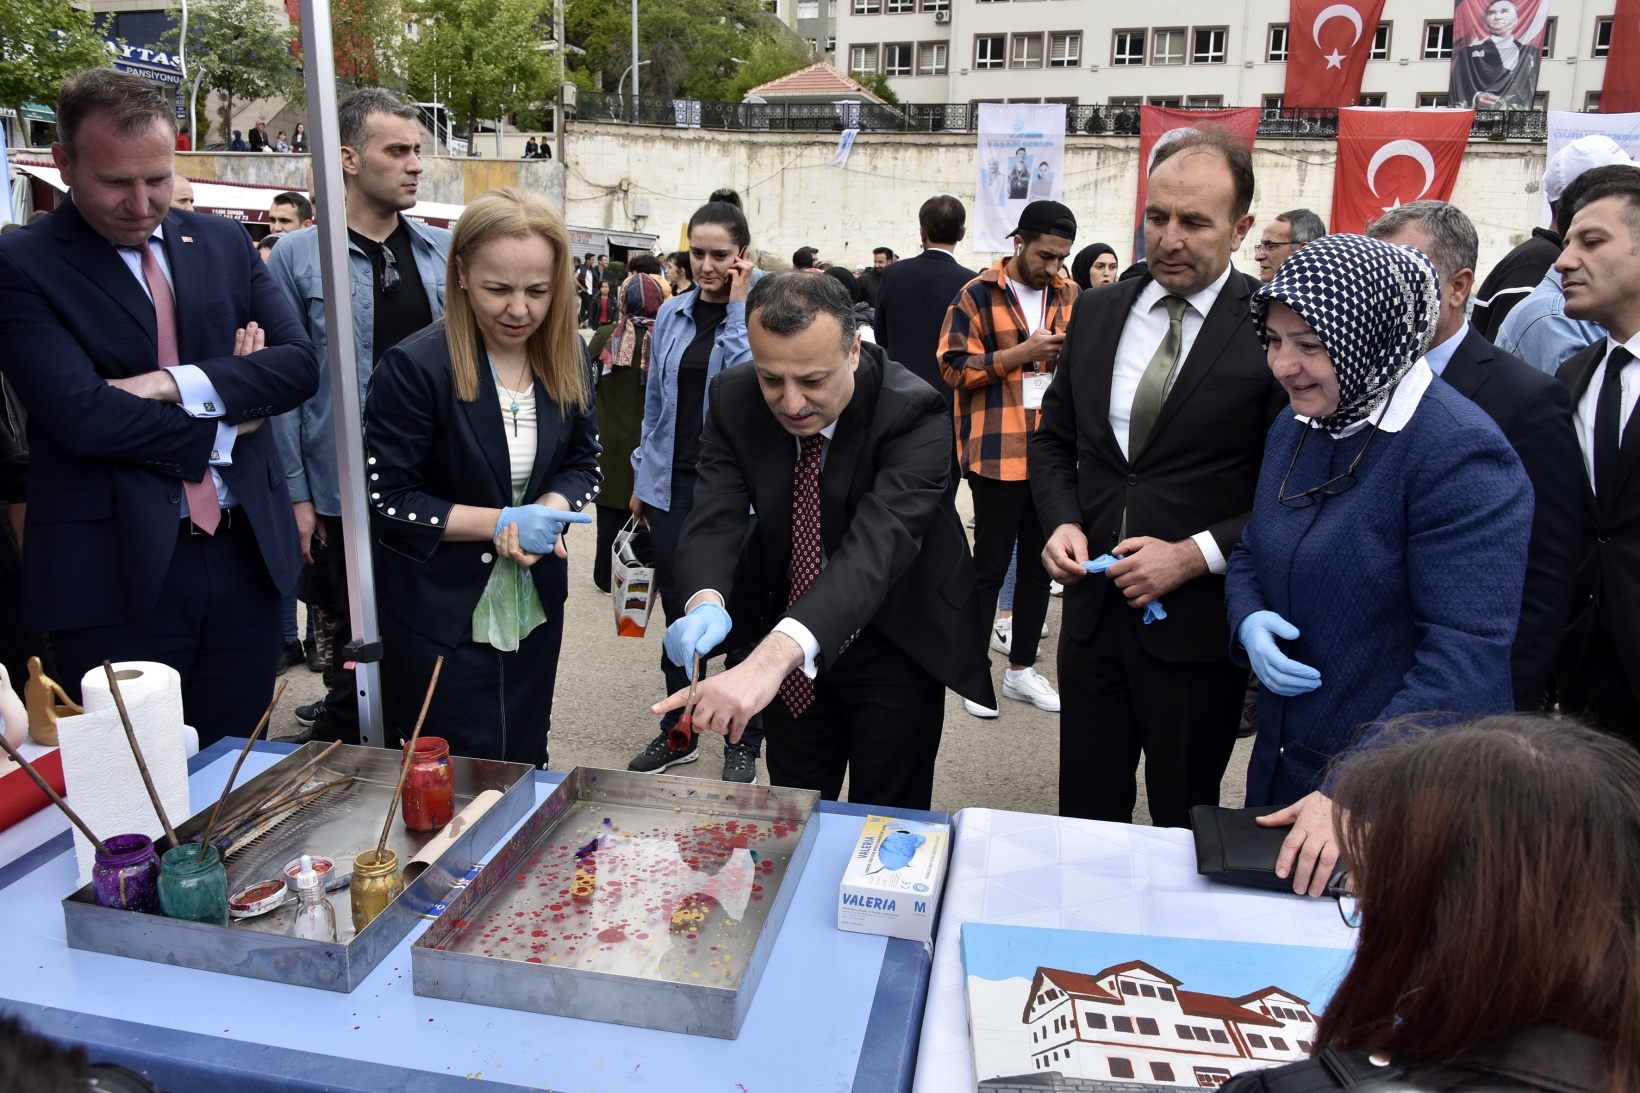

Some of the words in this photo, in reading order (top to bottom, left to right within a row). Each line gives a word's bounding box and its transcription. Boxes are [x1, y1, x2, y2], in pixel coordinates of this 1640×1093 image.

[126, 66, 180, 84] PANSİYONU
[857, 836, 876, 859] VALERIA
[843, 893, 896, 912] VALERIA
[914, 901, 926, 913] M
